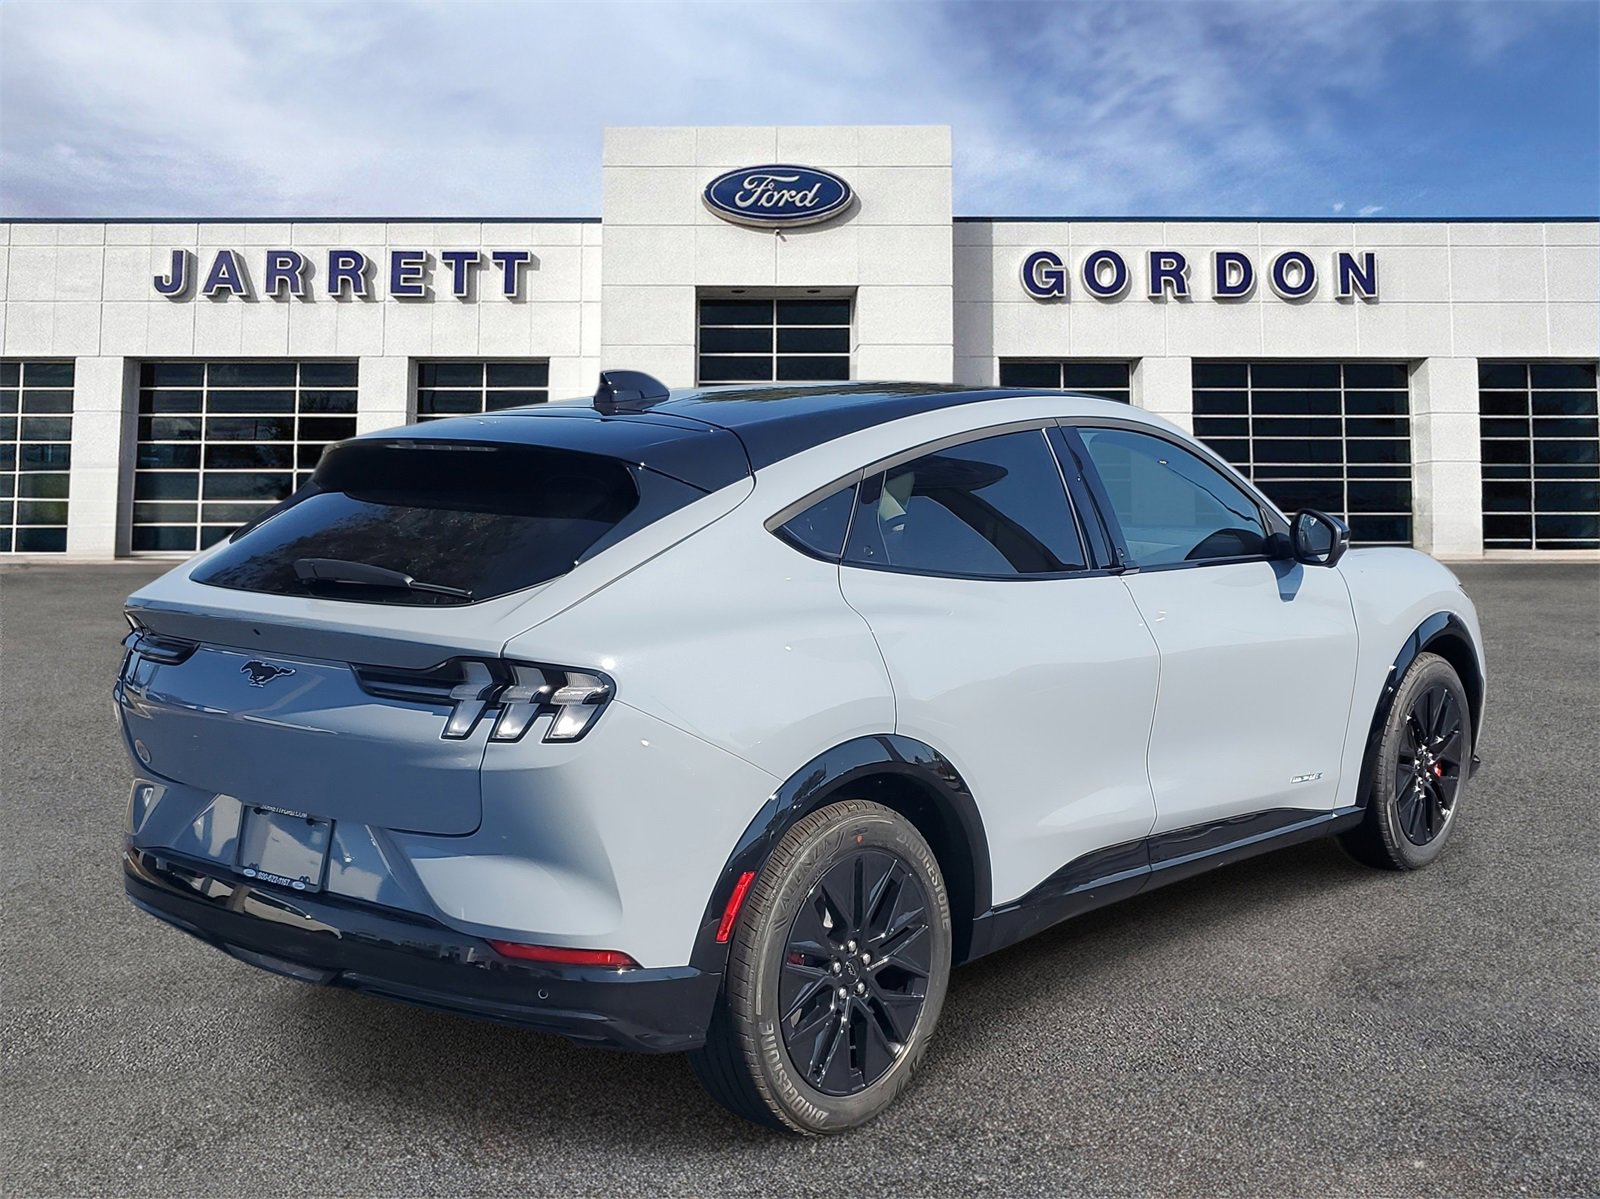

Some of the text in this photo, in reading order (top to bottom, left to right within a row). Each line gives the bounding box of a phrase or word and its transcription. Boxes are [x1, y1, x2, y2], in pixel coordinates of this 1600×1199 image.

[735, 174, 821, 207] Ford
[153, 248, 531, 298] JARRETT
[1020, 249, 1380, 300] GORDON
[760, 1022, 829, 1125] BRIDGESTONE
